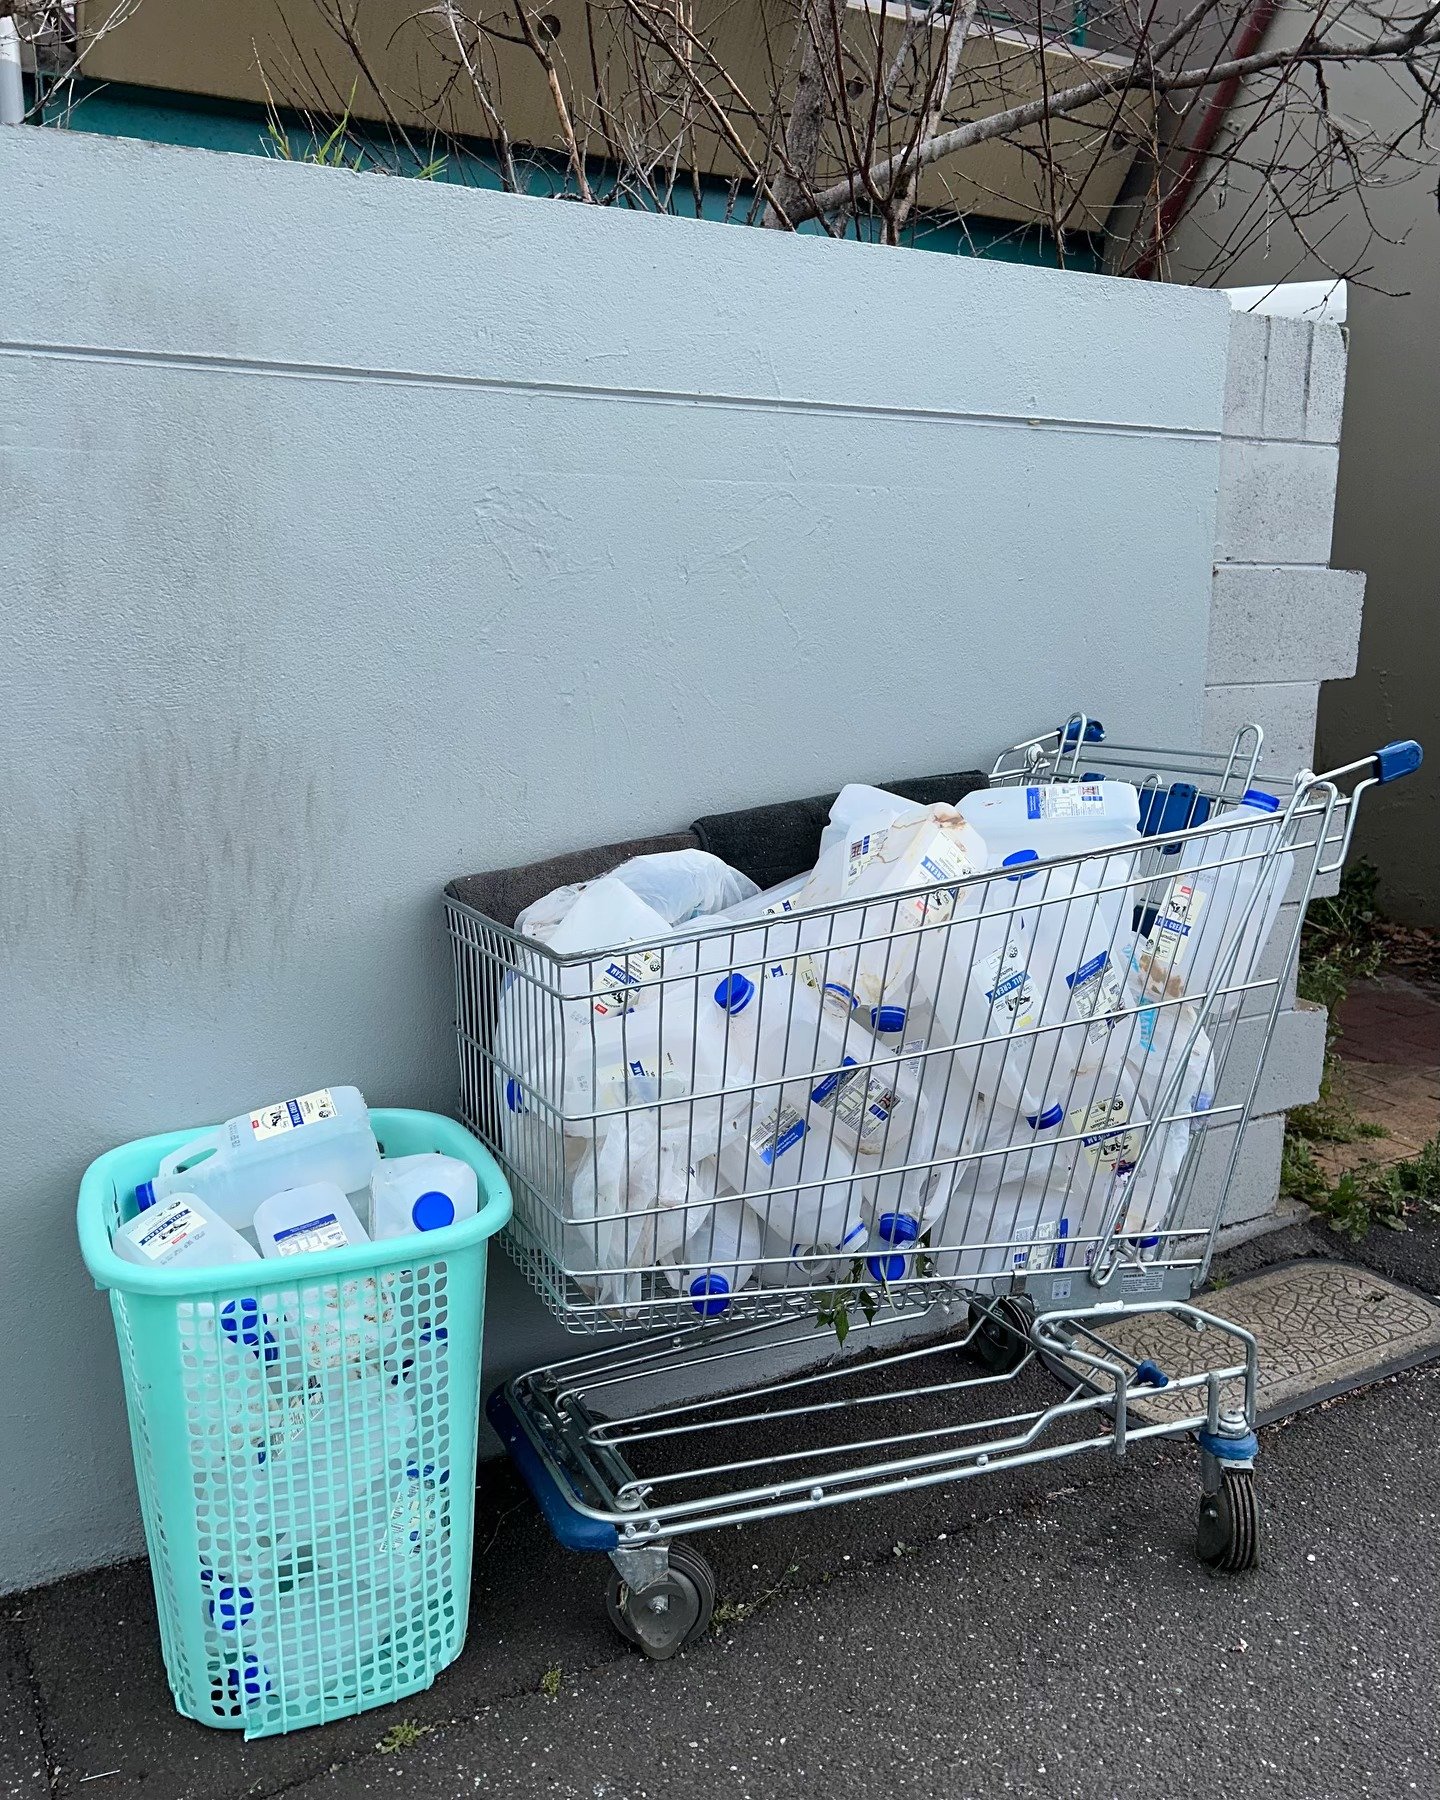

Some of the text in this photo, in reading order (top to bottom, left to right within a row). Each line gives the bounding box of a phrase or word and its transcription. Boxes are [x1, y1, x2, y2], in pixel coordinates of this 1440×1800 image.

[989, 981, 1013, 999] CREA
[291, 1112, 301, 1123] FULL
[168, 1211, 185, 1224] FULL
[143, 1222, 167, 1241] CREAM
